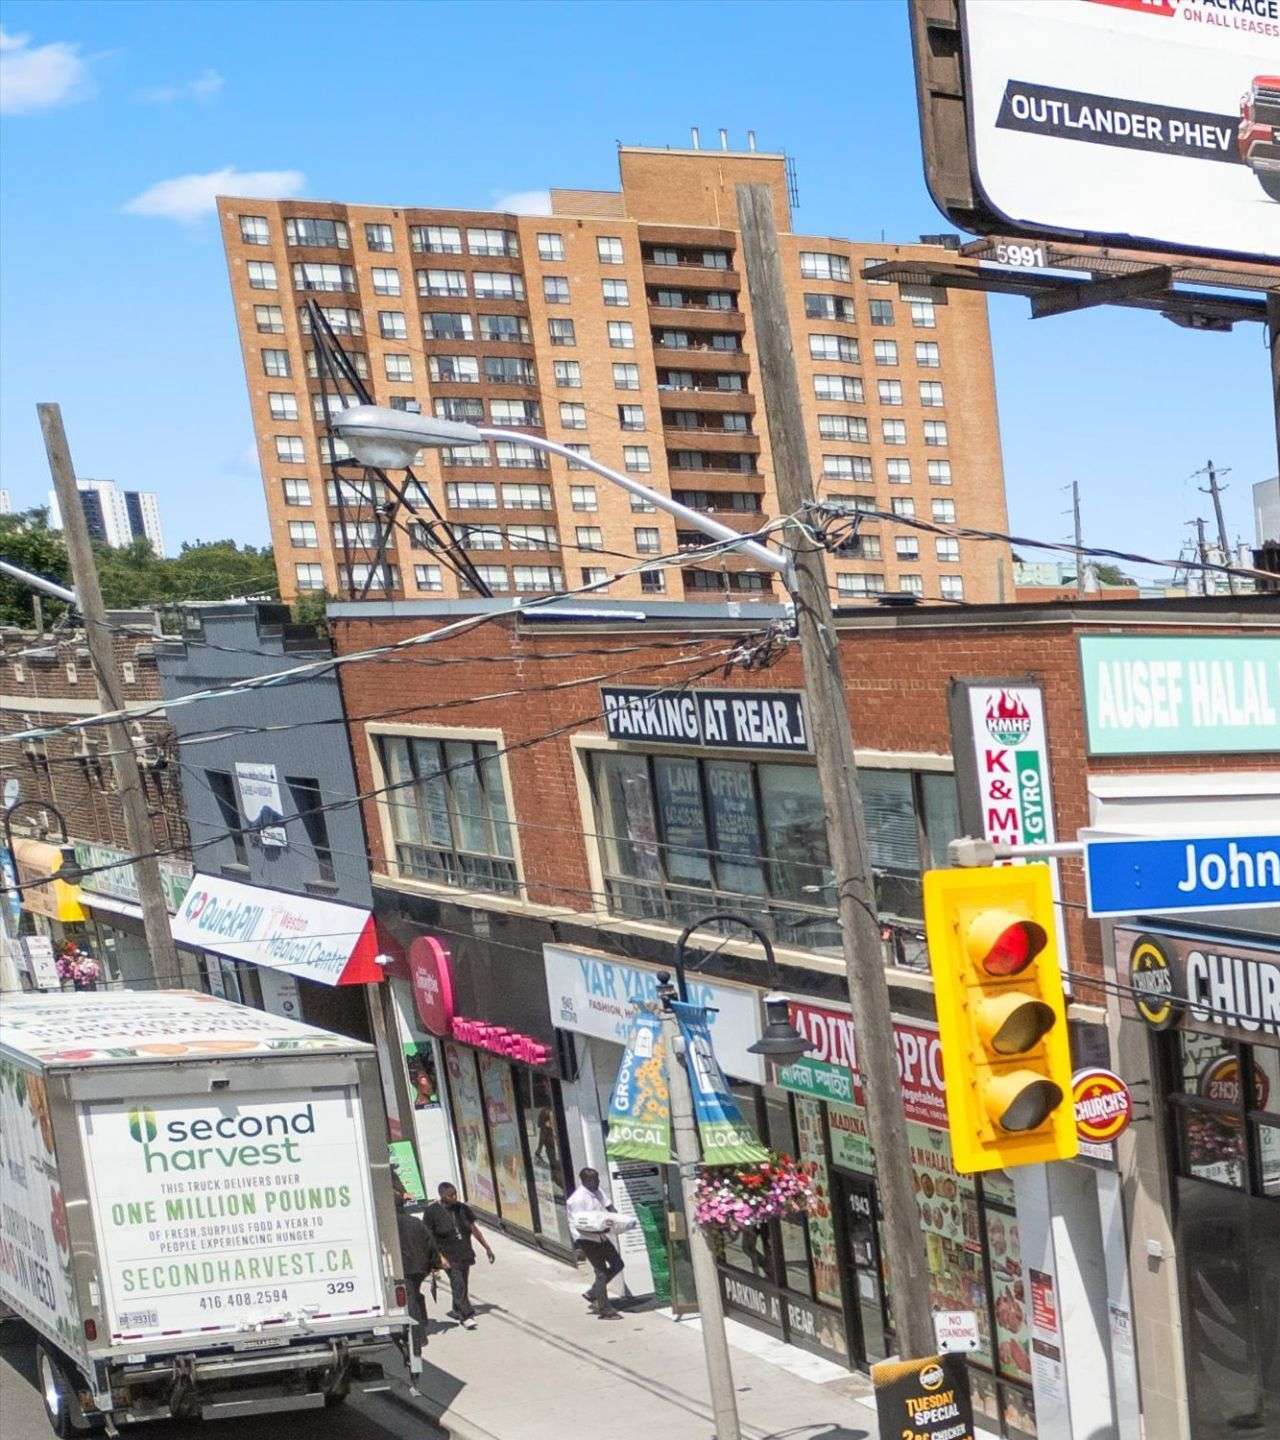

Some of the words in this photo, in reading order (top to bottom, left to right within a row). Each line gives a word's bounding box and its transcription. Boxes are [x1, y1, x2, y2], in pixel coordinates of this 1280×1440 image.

[1183, 8, 1202, 23] ON
[1206, 14, 1230, 28] ALL
[1233, 18, 1280, 37] LEASES
[1011, 94, 1163, 141] OUTLANDER
[1169, 120, 1231, 150] PHEV
[997, 244, 1044, 267] 5991
[1097, 660, 1183, 729] AUSEF
[1188, 659, 1277, 727] HALAL
[604, 694, 700, 738] PARKING
[703, 699, 728, 741] AT
[731, 699, 793, 744] REAR
[985, 749, 1011, 773] K
[1020, 769, 1044, 834] GYRO
[578, 958, 618, 999] YAR
[796, 1010, 857, 1070] ADIN
[167, 1104, 316, 1142] second
[1075, 1091, 1128, 1122] CHURCH'S
[612, 1126, 666, 1146] LOCAL
[143, 1138, 302, 1173] harvest
[161, 1183, 184, 1194] THIS
[188, 1179, 221, 1191] TRUCK
[225, 1175, 272, 1189] DELIVERS
[275, 1173, 300, 1184] OVER
[112, 1200, 157, 1226] ONE
[165, 1192, 257, 1221] MILLION
[265, 1186, 351, 1213] POUNDS
[149, 1229, 161, 1241] OF
[165, 1227, 196, 1240] FRESH
[200, 1223, 244, 1237] SURPLUS
[248, 1220, 273, 1232] FOOD
[276, 1219, 282, 1230] A
[285, 1217, 308, 1229] YEAR
[312, 1216, 323, 1226] TO
[160, 1240, 196, 1253] PEOPLE
[200, 1234, 273, 1249] EXPERIENCING
[276, 1230, 315, 1242] HUNGER
[122, 1248, 354, 1292] SECONDHARVEST.CA
[326, 1281, 355, 1295] 329
[724, 1276, 767, 1315] PARKING
[787, 1303, 816, 1336] REAR
[905, 1391, 954, 1417] TUESDAY
[914, 1403, 960, 1426] SPECIAL
